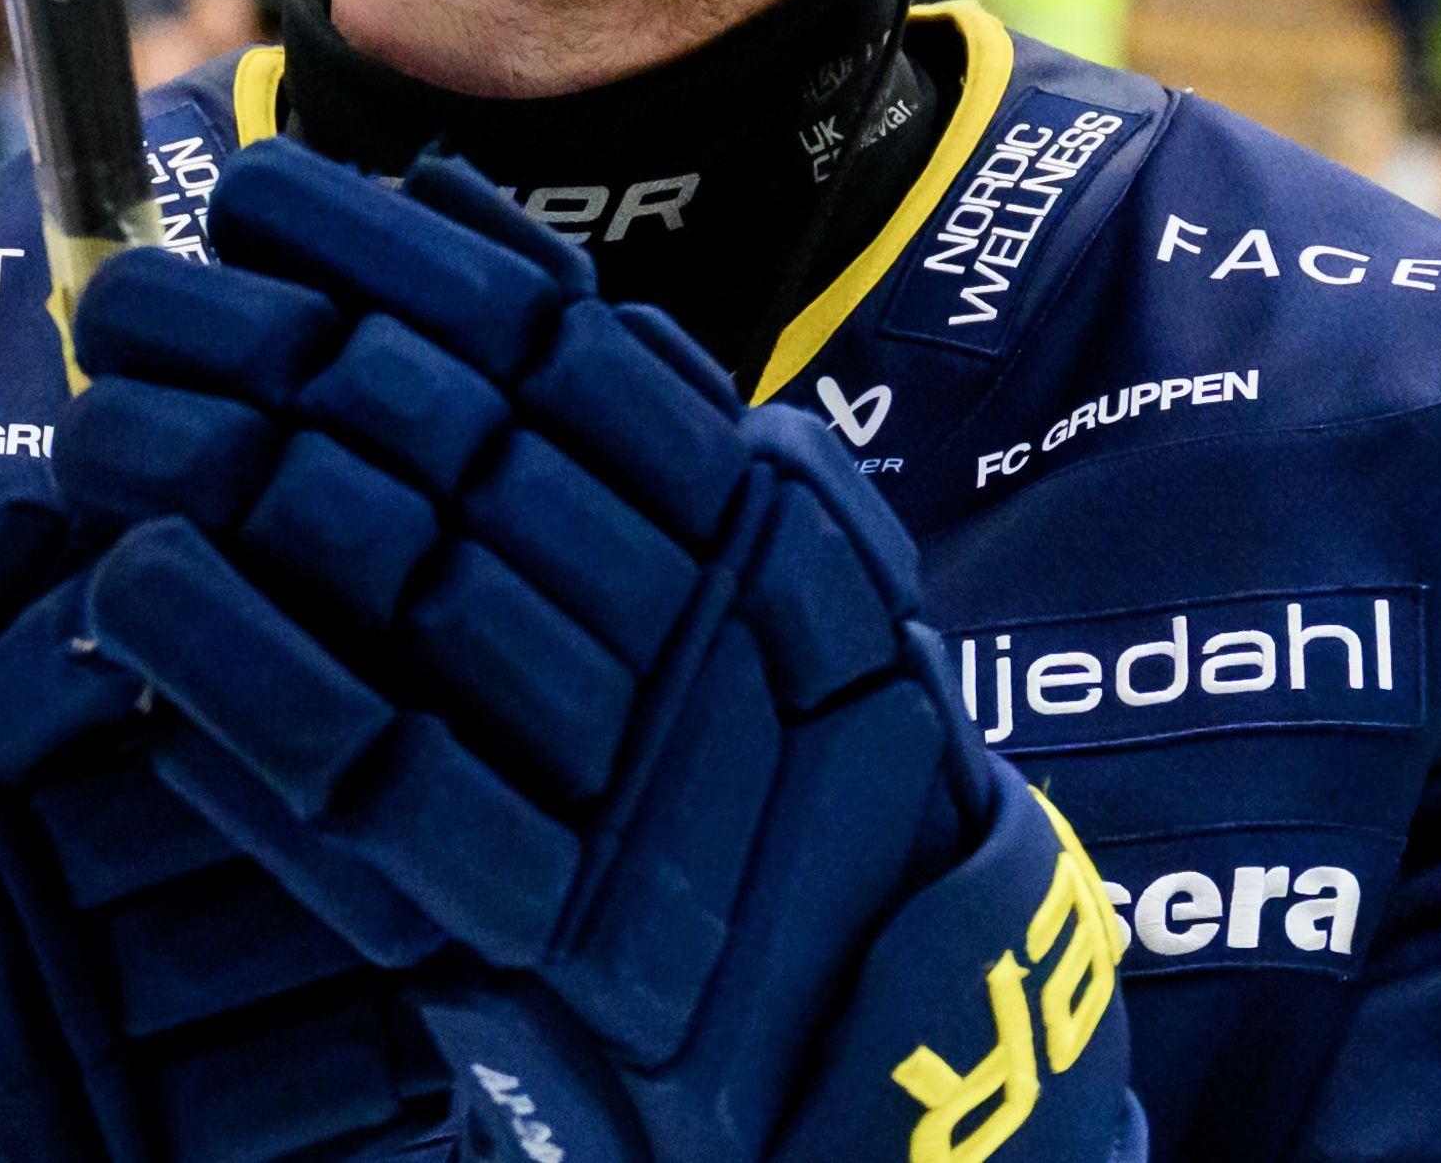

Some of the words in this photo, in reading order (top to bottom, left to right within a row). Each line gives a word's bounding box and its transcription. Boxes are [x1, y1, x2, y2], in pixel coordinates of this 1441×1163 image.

[924, 123, 1053, 274] NORDIC
[948, 111, 1123, 325] WELLNESS
[975, 441, 1030, 487] FC
[1041, 369, 1259, 450] GRUPPEN
